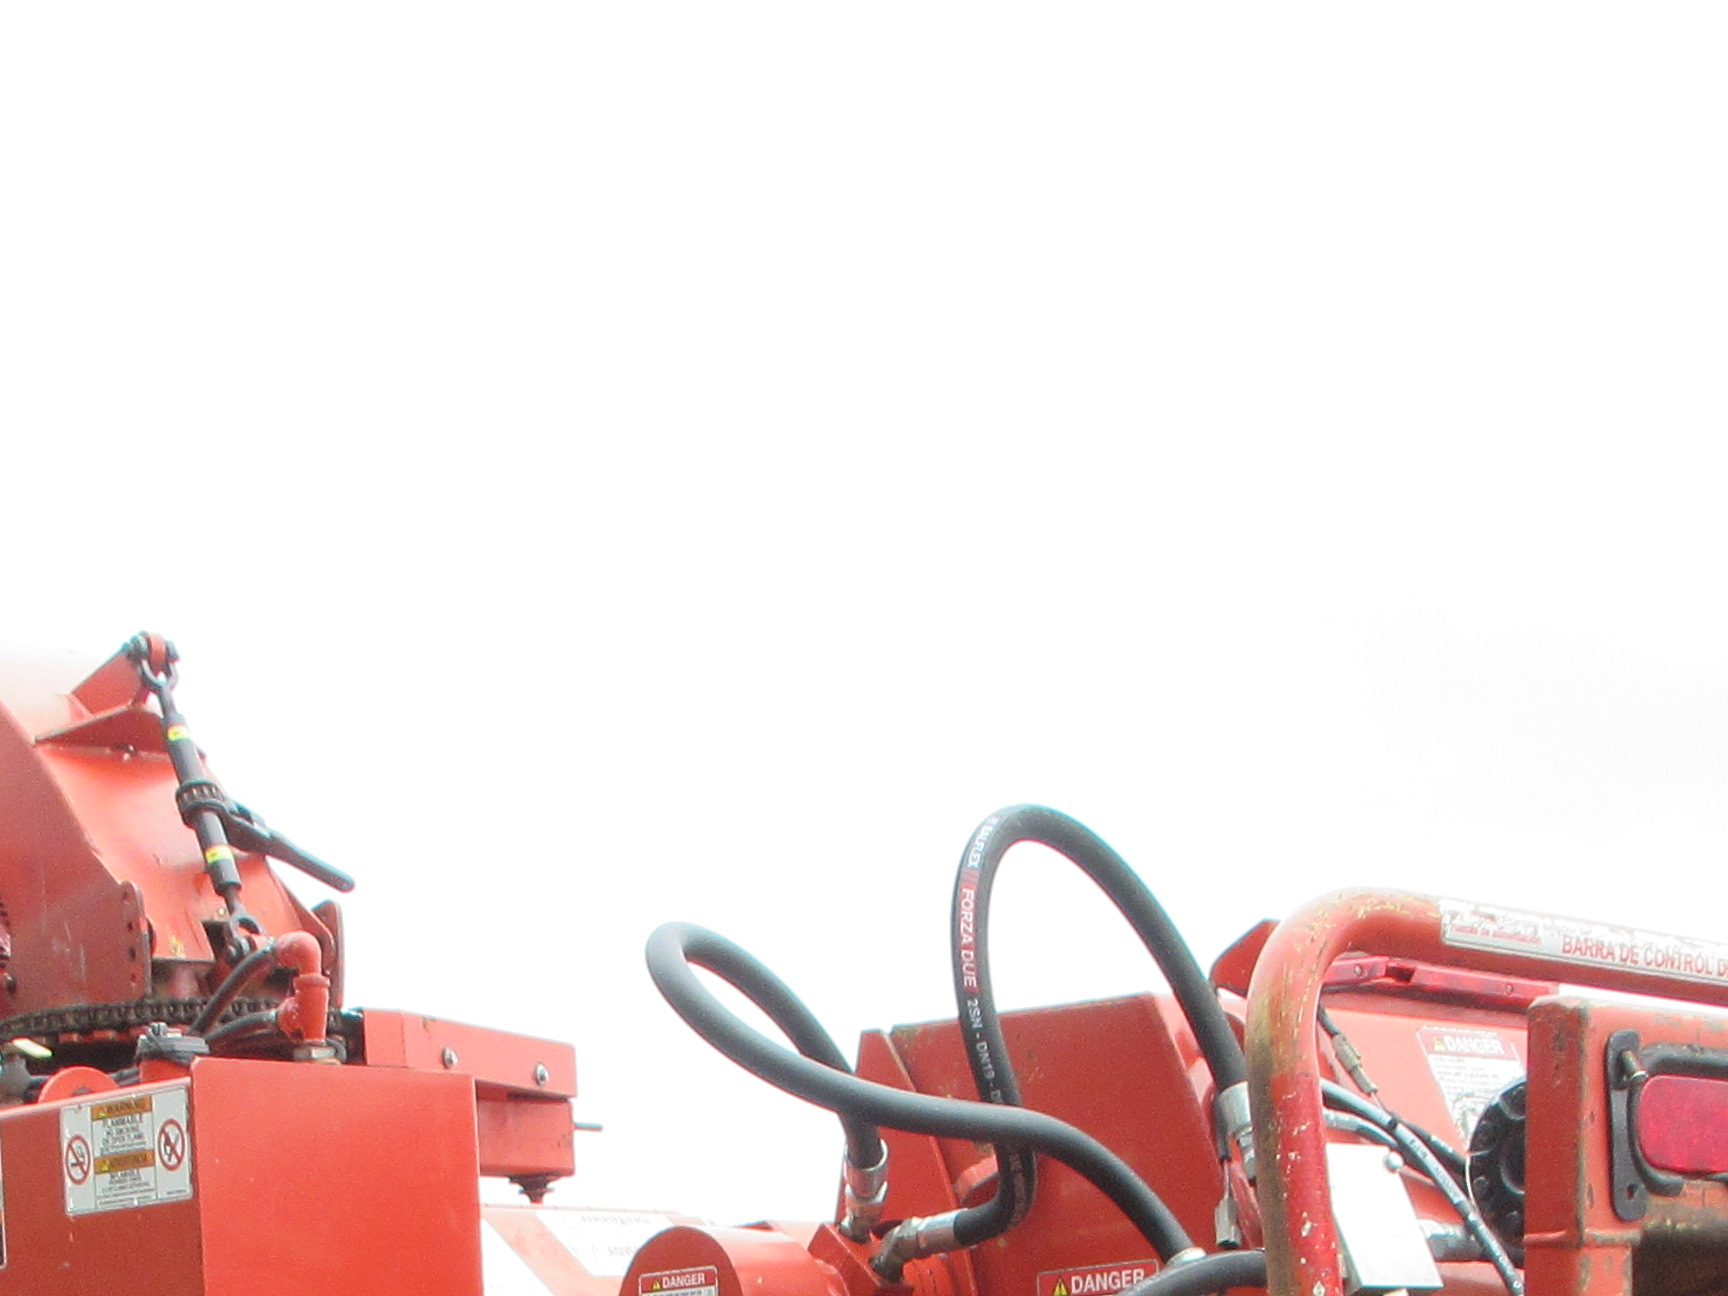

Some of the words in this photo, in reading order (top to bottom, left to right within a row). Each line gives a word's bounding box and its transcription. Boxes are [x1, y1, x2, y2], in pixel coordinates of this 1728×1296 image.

[960, 887, 975, 945] FORZA
[961, 949, 977, 988] DUE
[1562, 934, 1615, 962] BARRA
[1619, 942, 1639, 965] DE
[1643, 942, 1712, 975] CONTROL
[967, 998, 983, 1028] 2SN
[662, 1272, 706, 1289] DANGER
[1071, 1268, 1145, 1294] DANGER
